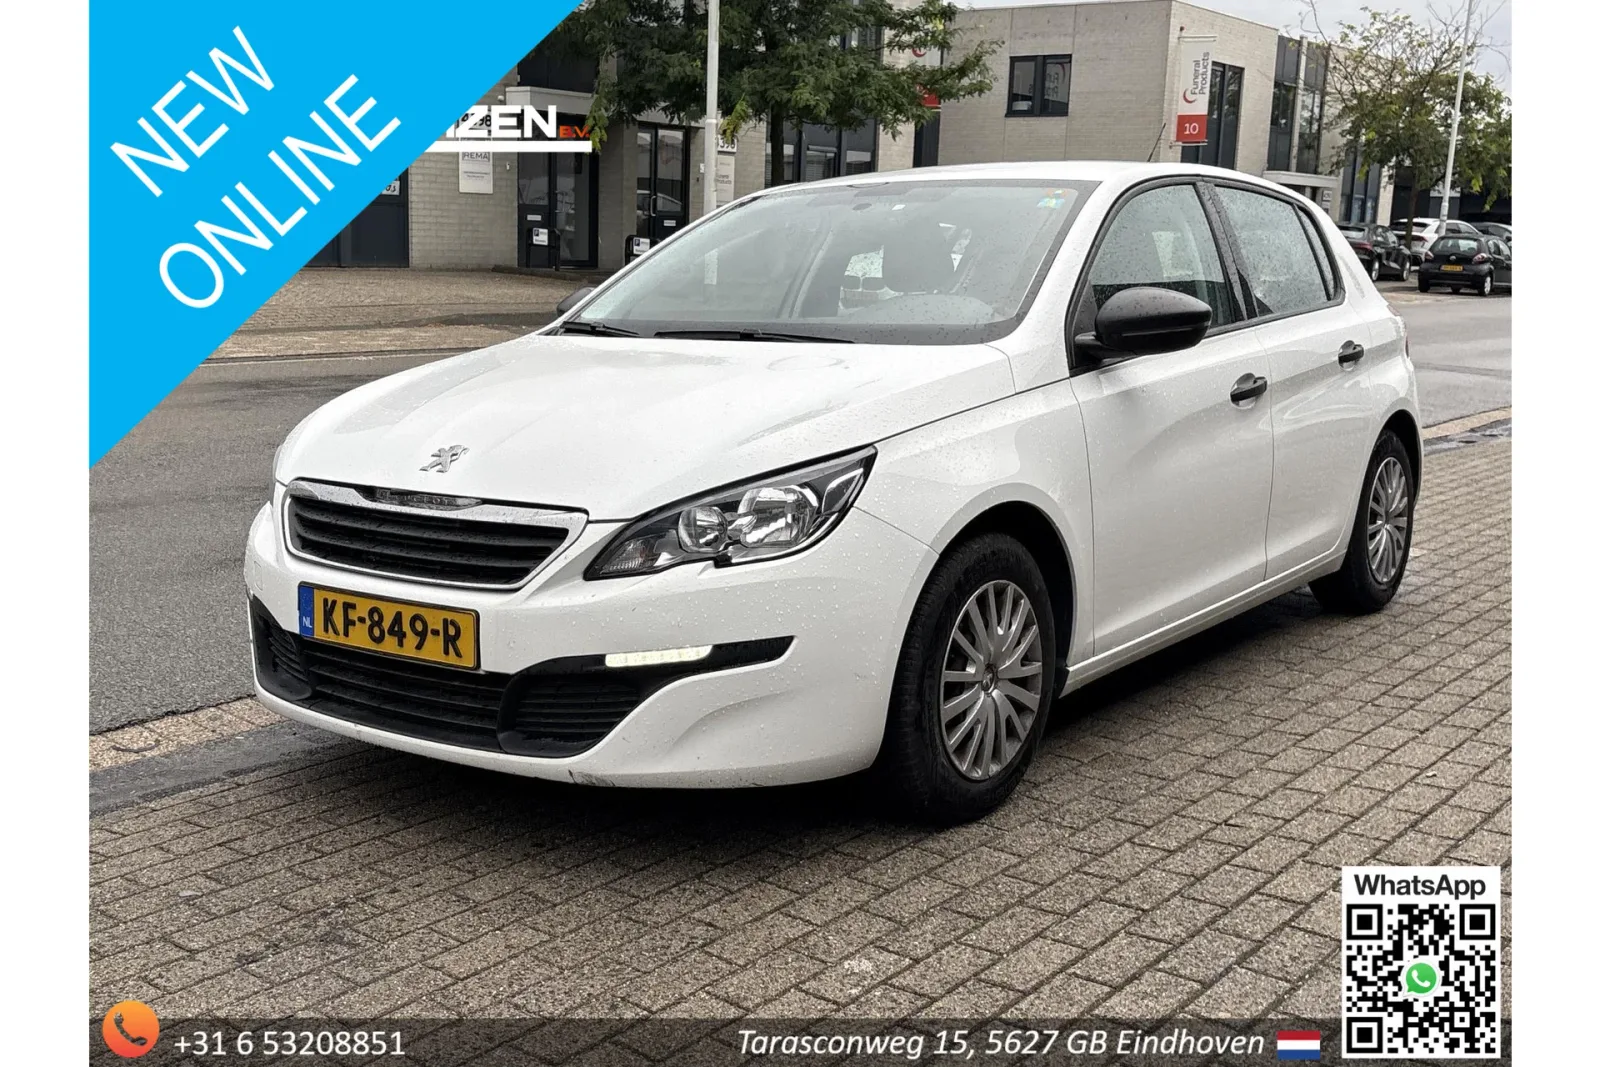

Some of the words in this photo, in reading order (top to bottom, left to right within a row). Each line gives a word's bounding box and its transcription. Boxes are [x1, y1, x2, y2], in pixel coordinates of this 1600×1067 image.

[1190, 60, 1201, 95] Funeral
[1198, 51, 1210, 95] Products
[1183, 122, 1199, 135] 10
[302, 616, 313, 628] NL
[322, 597, 463, 659] KF-849-R
